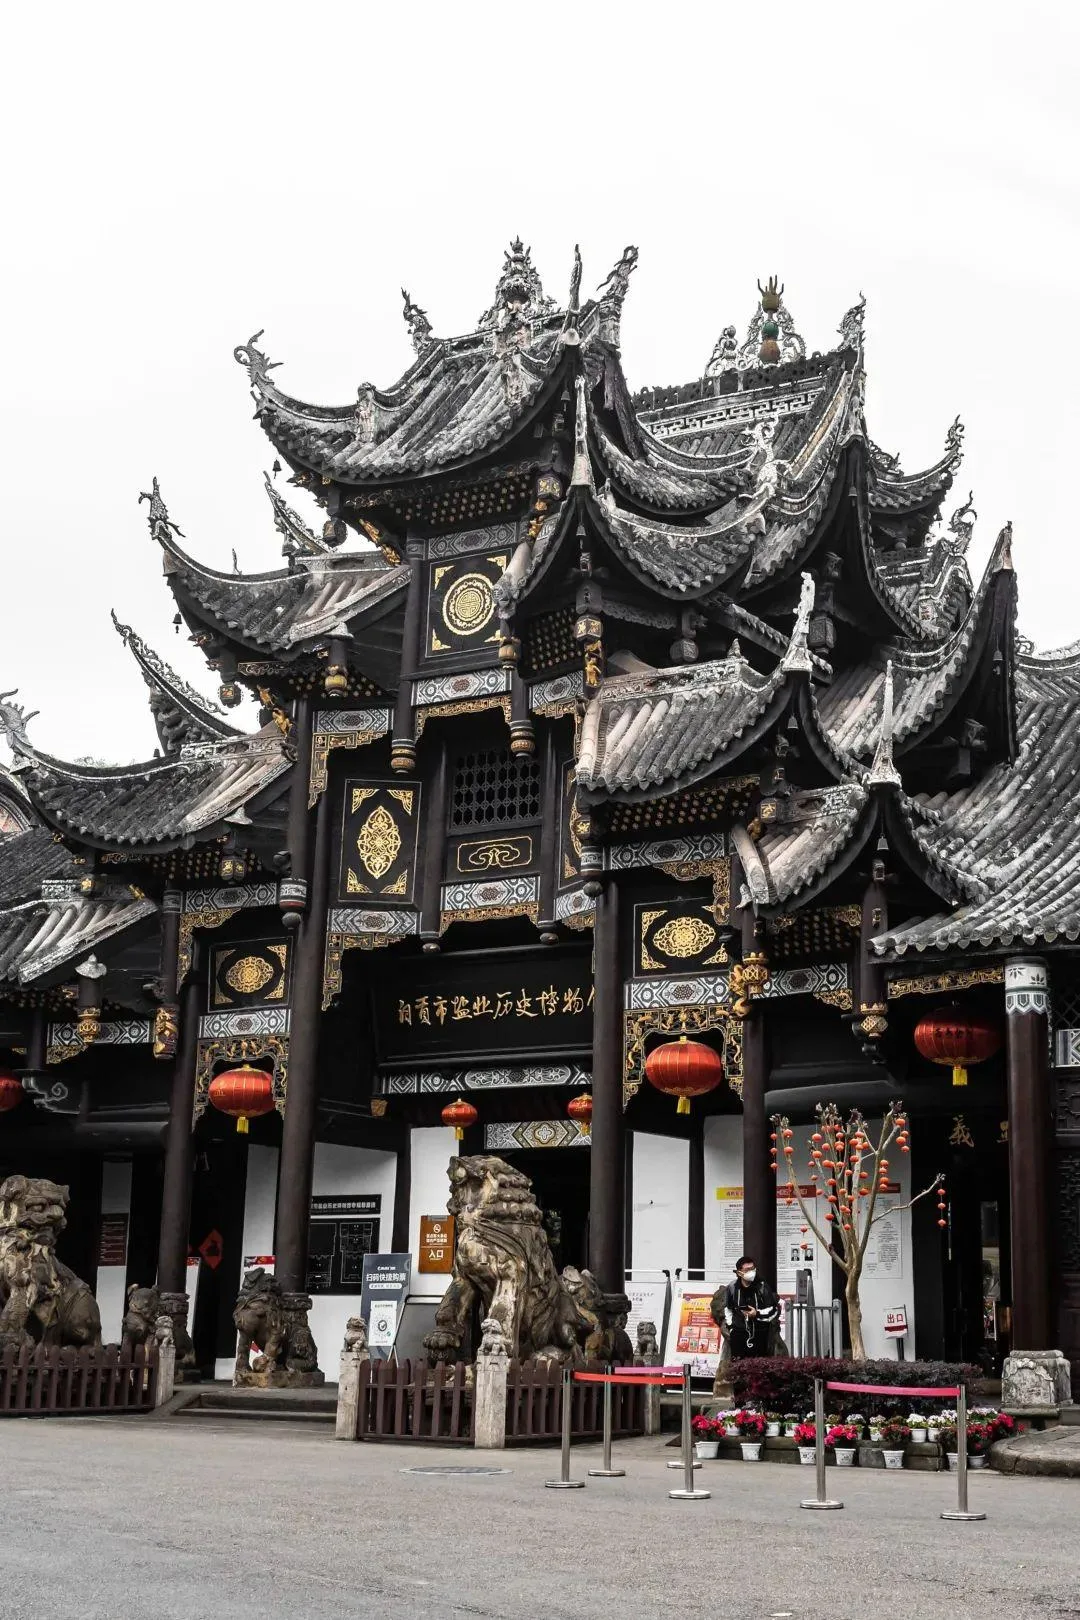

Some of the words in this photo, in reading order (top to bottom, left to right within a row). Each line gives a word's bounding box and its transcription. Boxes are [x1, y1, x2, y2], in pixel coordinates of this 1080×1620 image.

[429, 1249, 444, 1259] 入口
[366, 1272, 407, 1282] 扫码快捷购票
[887, 1313, 904, 1324] 出口
